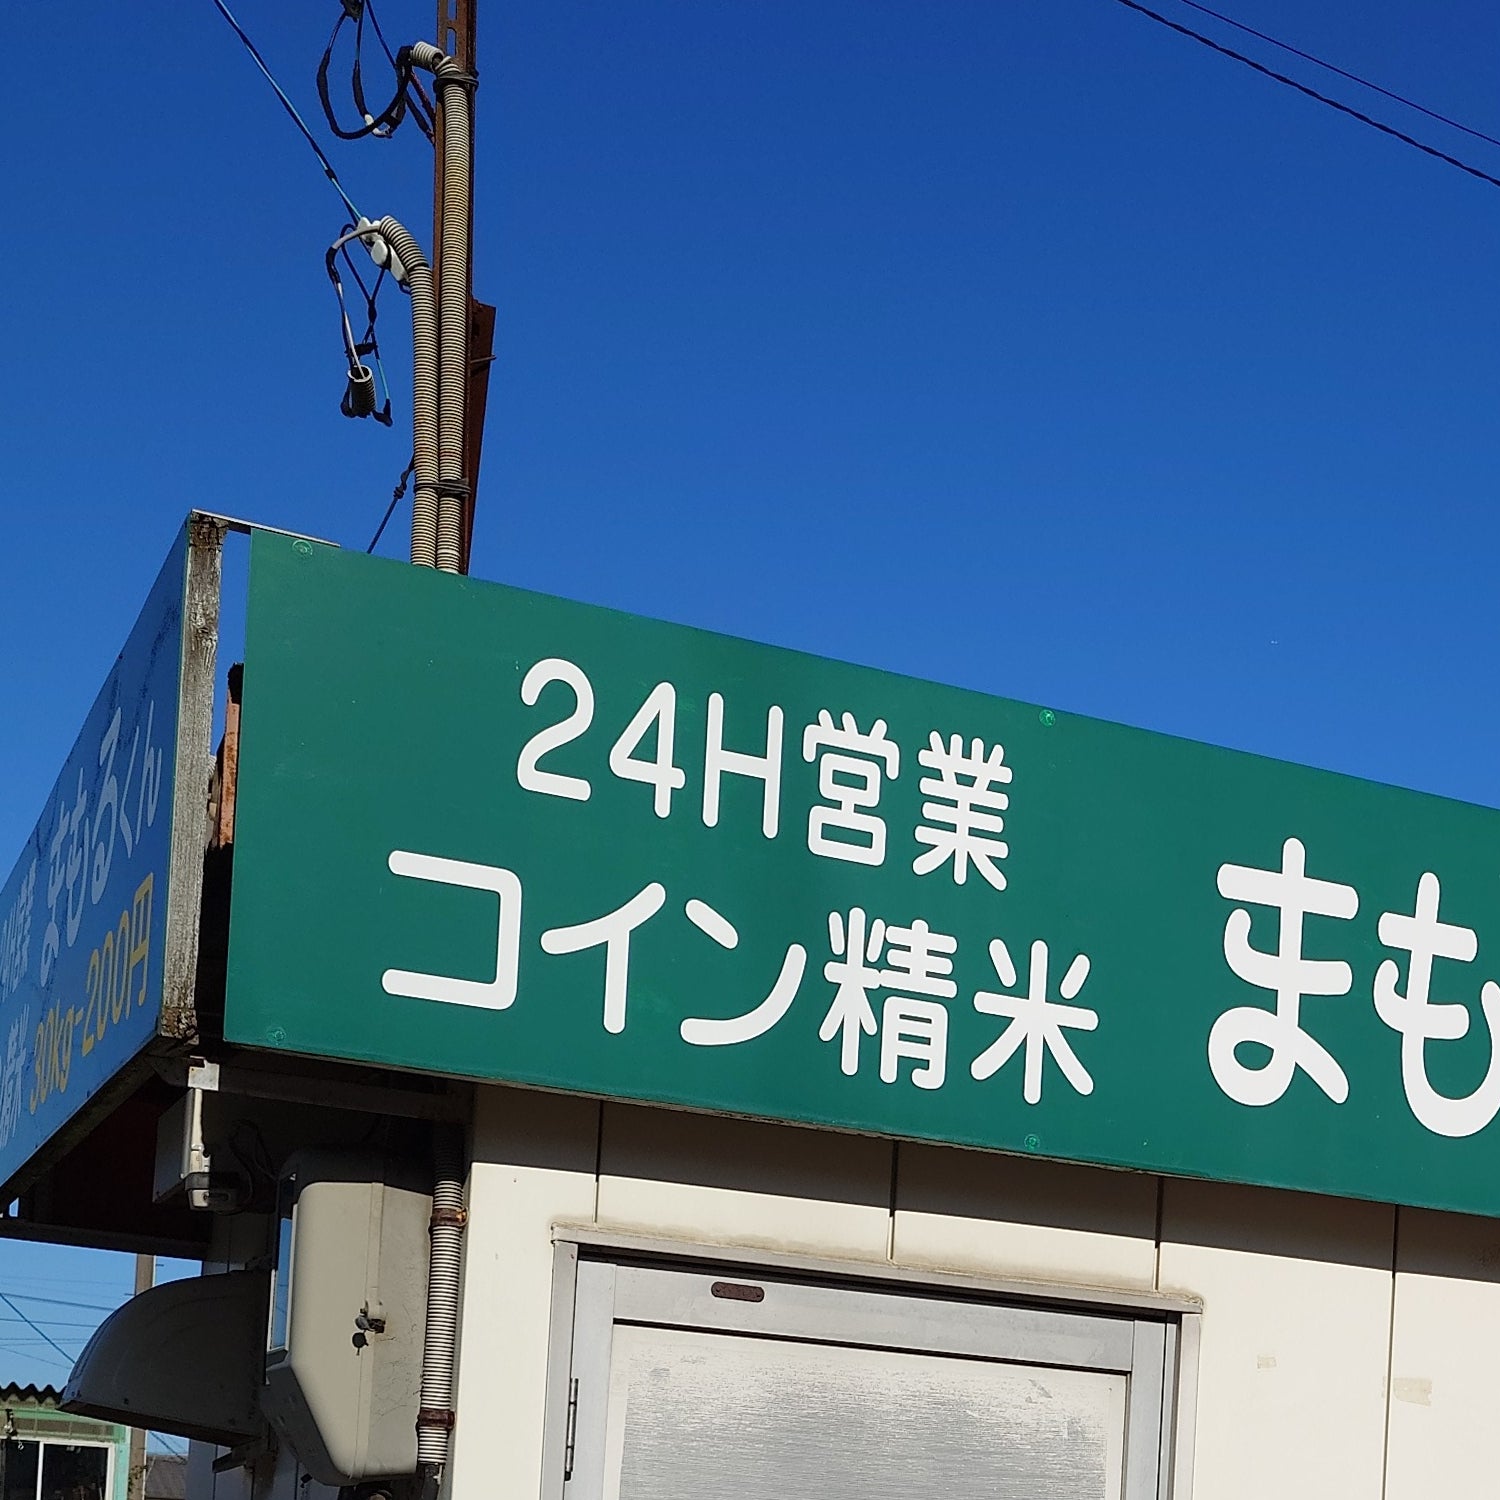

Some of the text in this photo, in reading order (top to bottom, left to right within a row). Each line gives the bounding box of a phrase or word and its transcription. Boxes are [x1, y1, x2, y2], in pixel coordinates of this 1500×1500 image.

[40, 699, 163, 988] まもるくん
[517, 658, 1013, 891] 24H営業
[30, 872, 154, 1116] 30kg-200円
[382, 850, 1099, 1104] コイン精米
